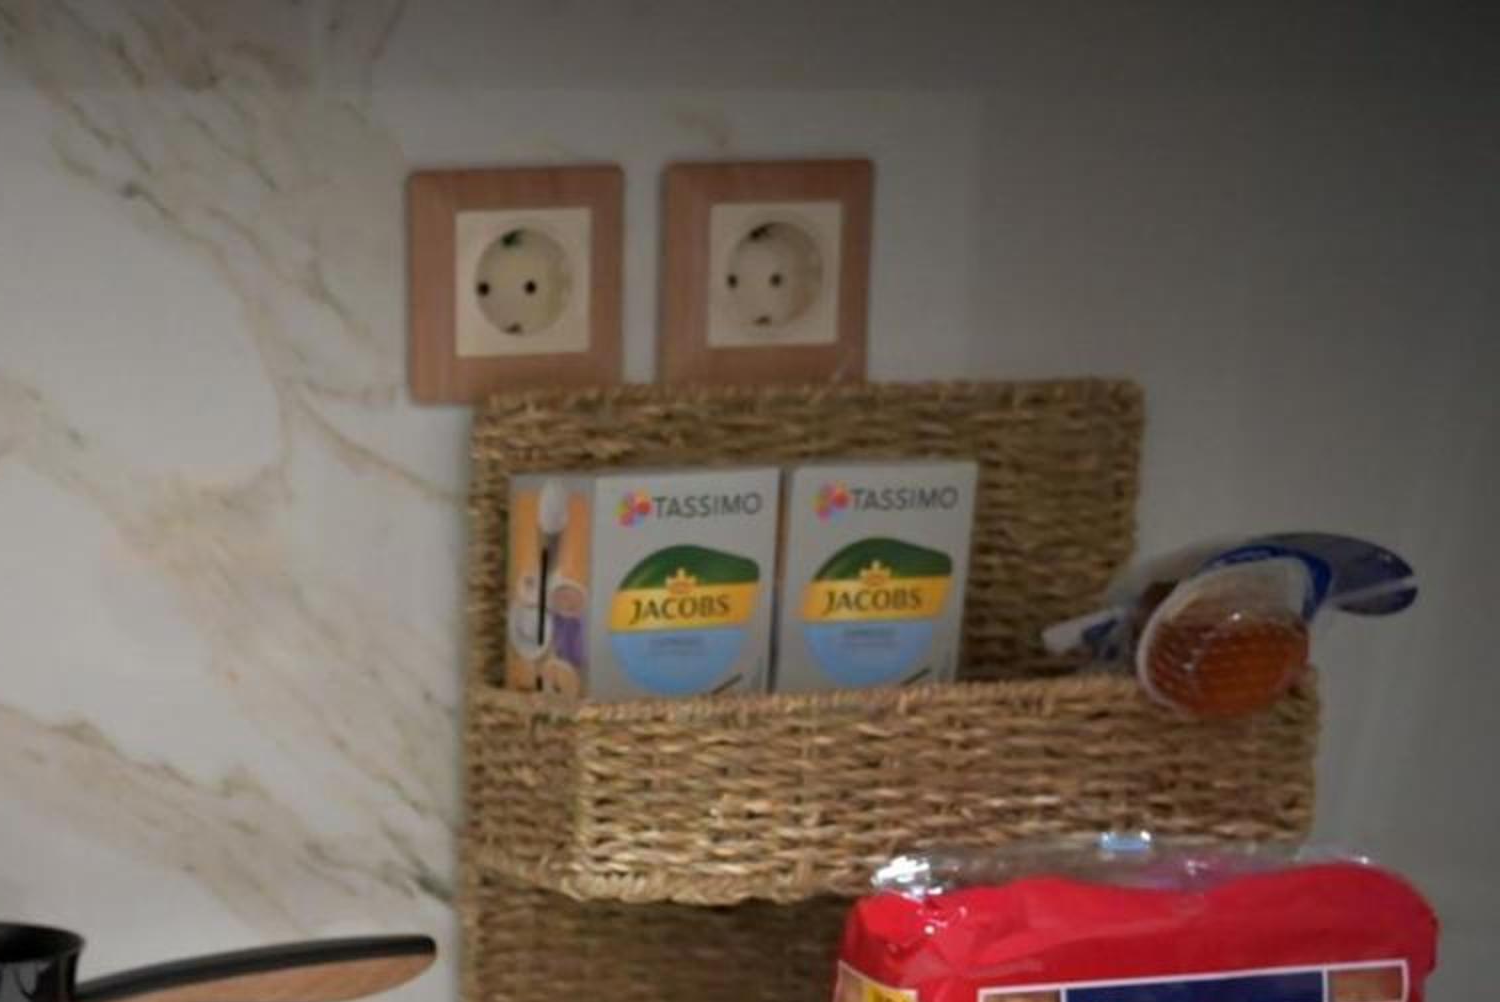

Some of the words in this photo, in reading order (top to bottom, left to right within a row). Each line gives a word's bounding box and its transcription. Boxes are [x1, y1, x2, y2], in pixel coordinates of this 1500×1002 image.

[652, 491, 763, 519] TASSIMO
[850, 486, 959, 512] TASSIMO
[629, 594, 731, 625] JACOBS
[821, 587, 924, 616] JACOBS
